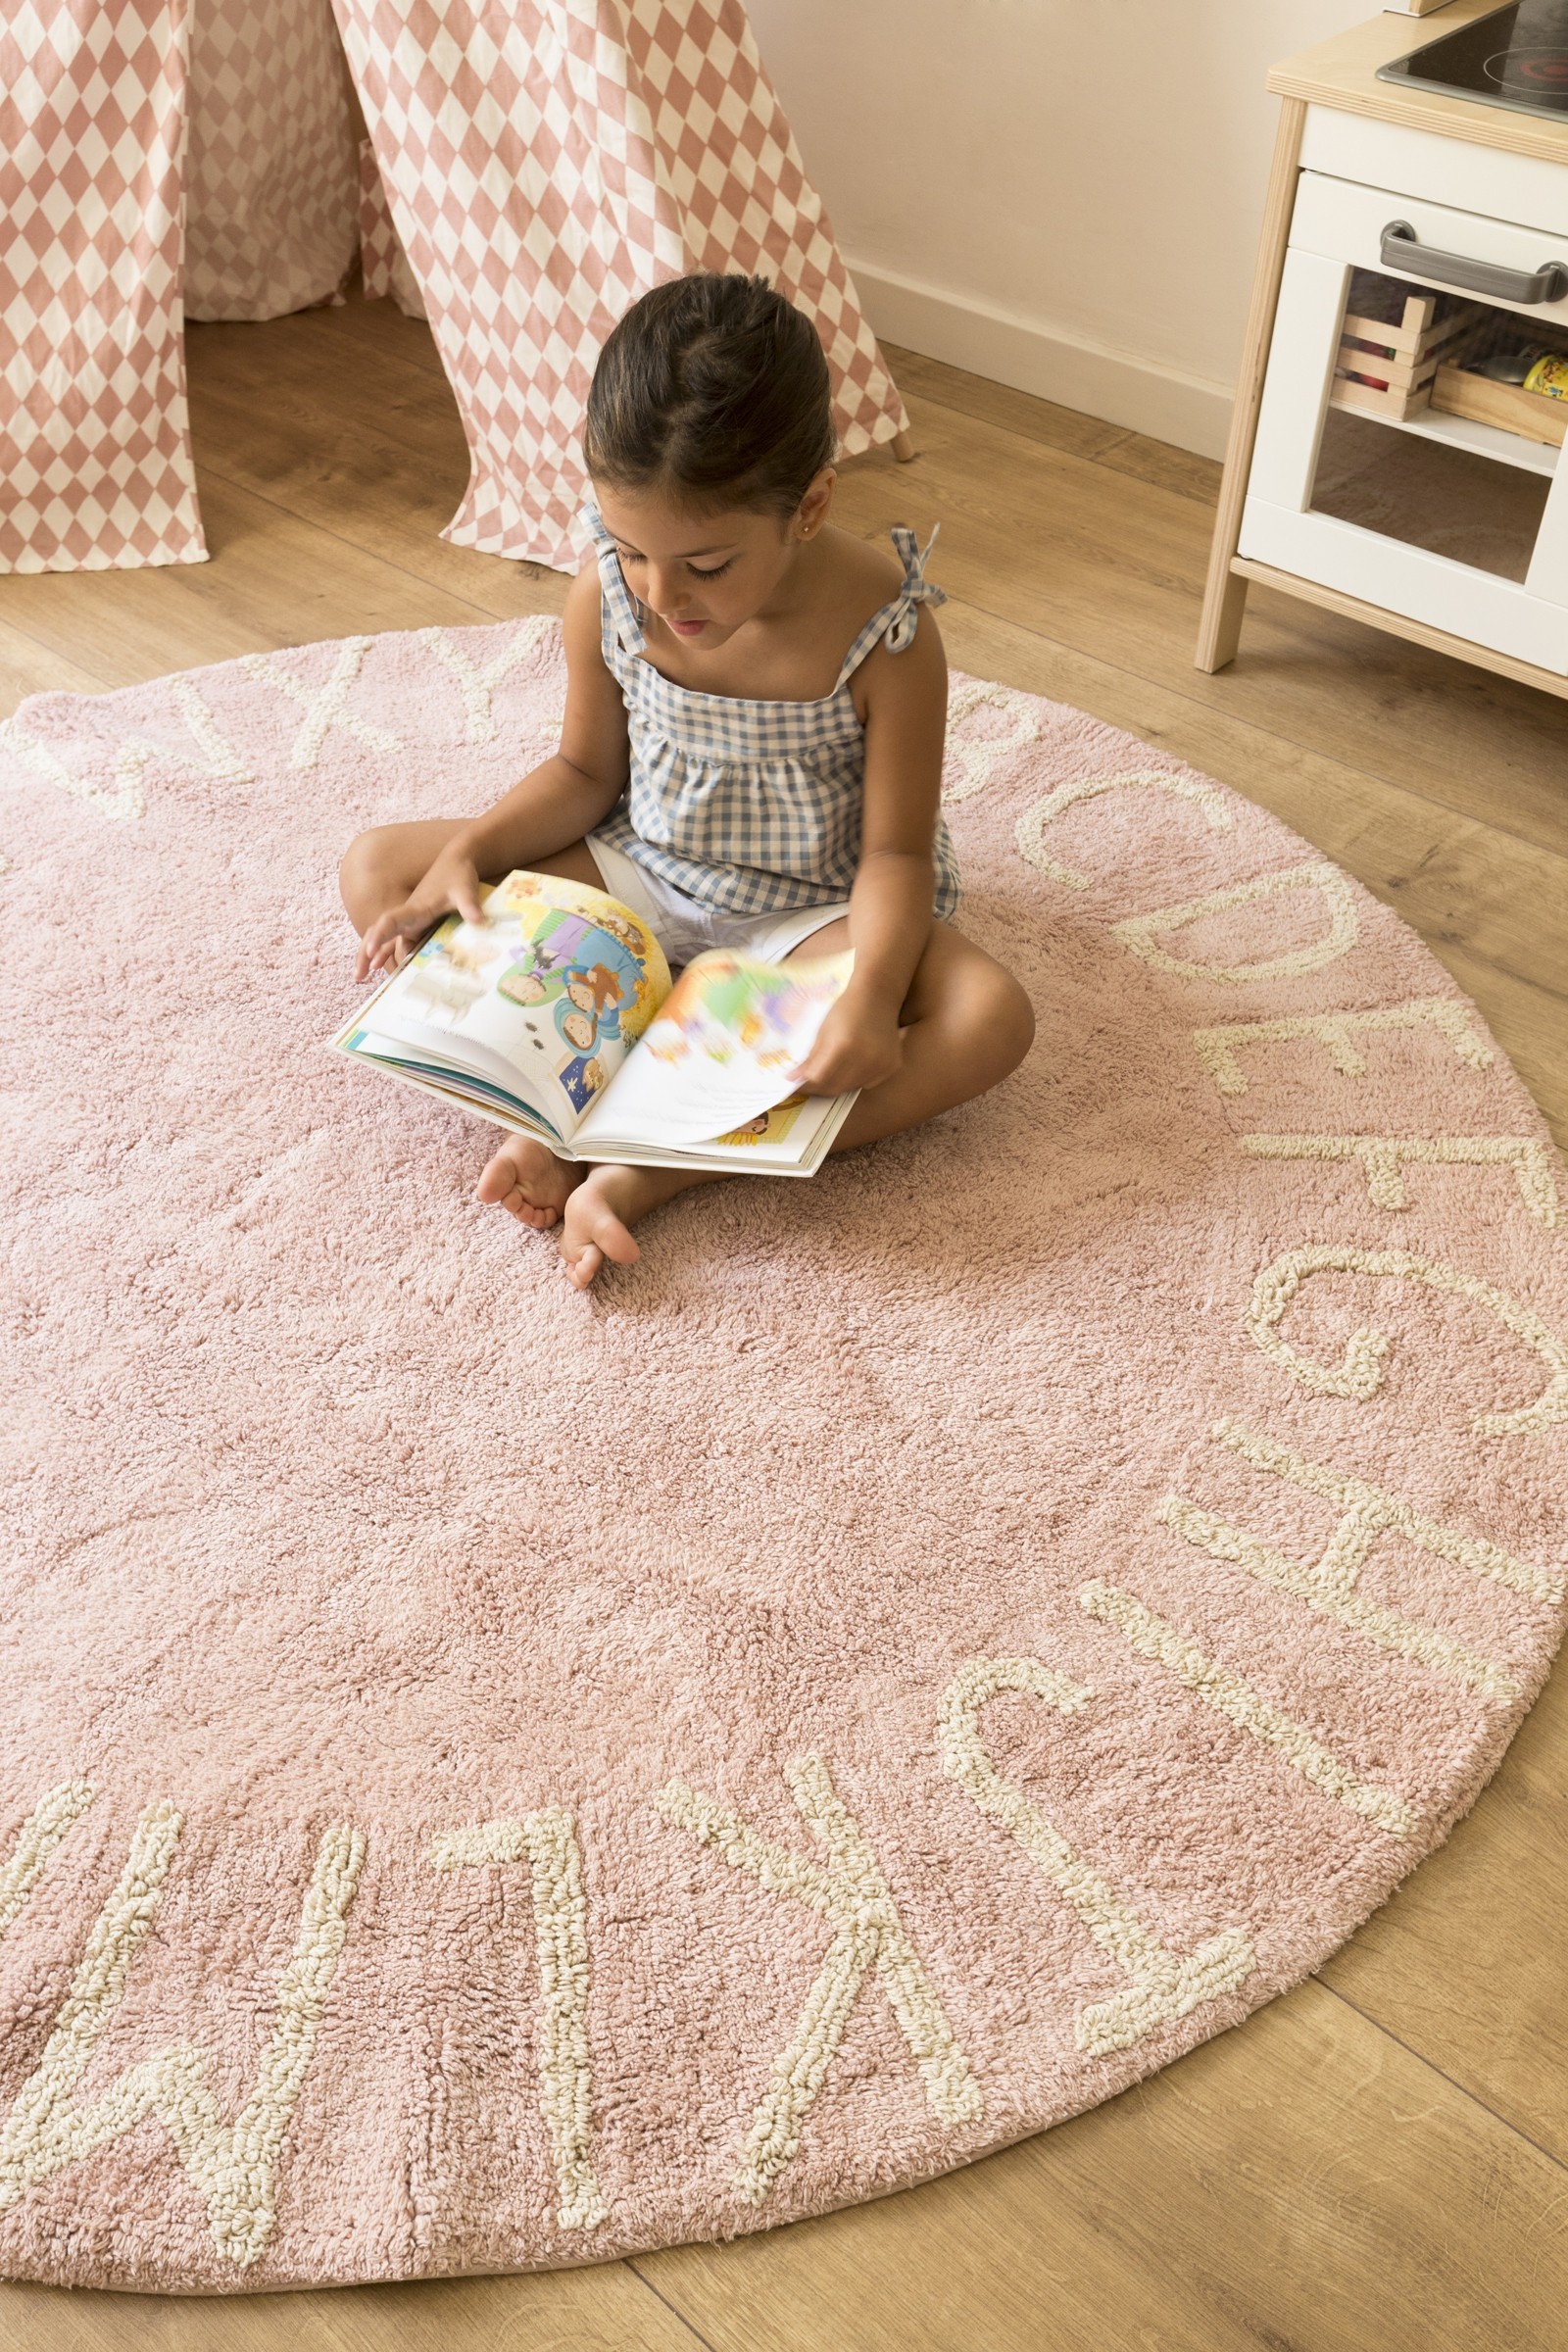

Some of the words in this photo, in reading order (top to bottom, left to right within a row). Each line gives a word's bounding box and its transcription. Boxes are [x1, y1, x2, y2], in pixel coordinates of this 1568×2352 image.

[0, 671, 256, 819] W
[238, 653, 405, 771] X
[417, 614, 556, 743] Y
[940, 680, 1039, 803] B
[1013, 769, 1232, 891] C
[1107, 859, 1360, 985] D
[1191, 997, 1494, 1096] E
[1242, 1133, 1564, 1228] F
[1246, 1243, 1568, 1437] G
[1156, 1415, 1565, 1703] H
[1079, 1579, 1421, 1842] I
[937, 1656, 1256, 2056] J
[0, 1799, 367, 2268] M
[427, 1805, 605, 2230] L
[655, 1752, 984, 2207] K
